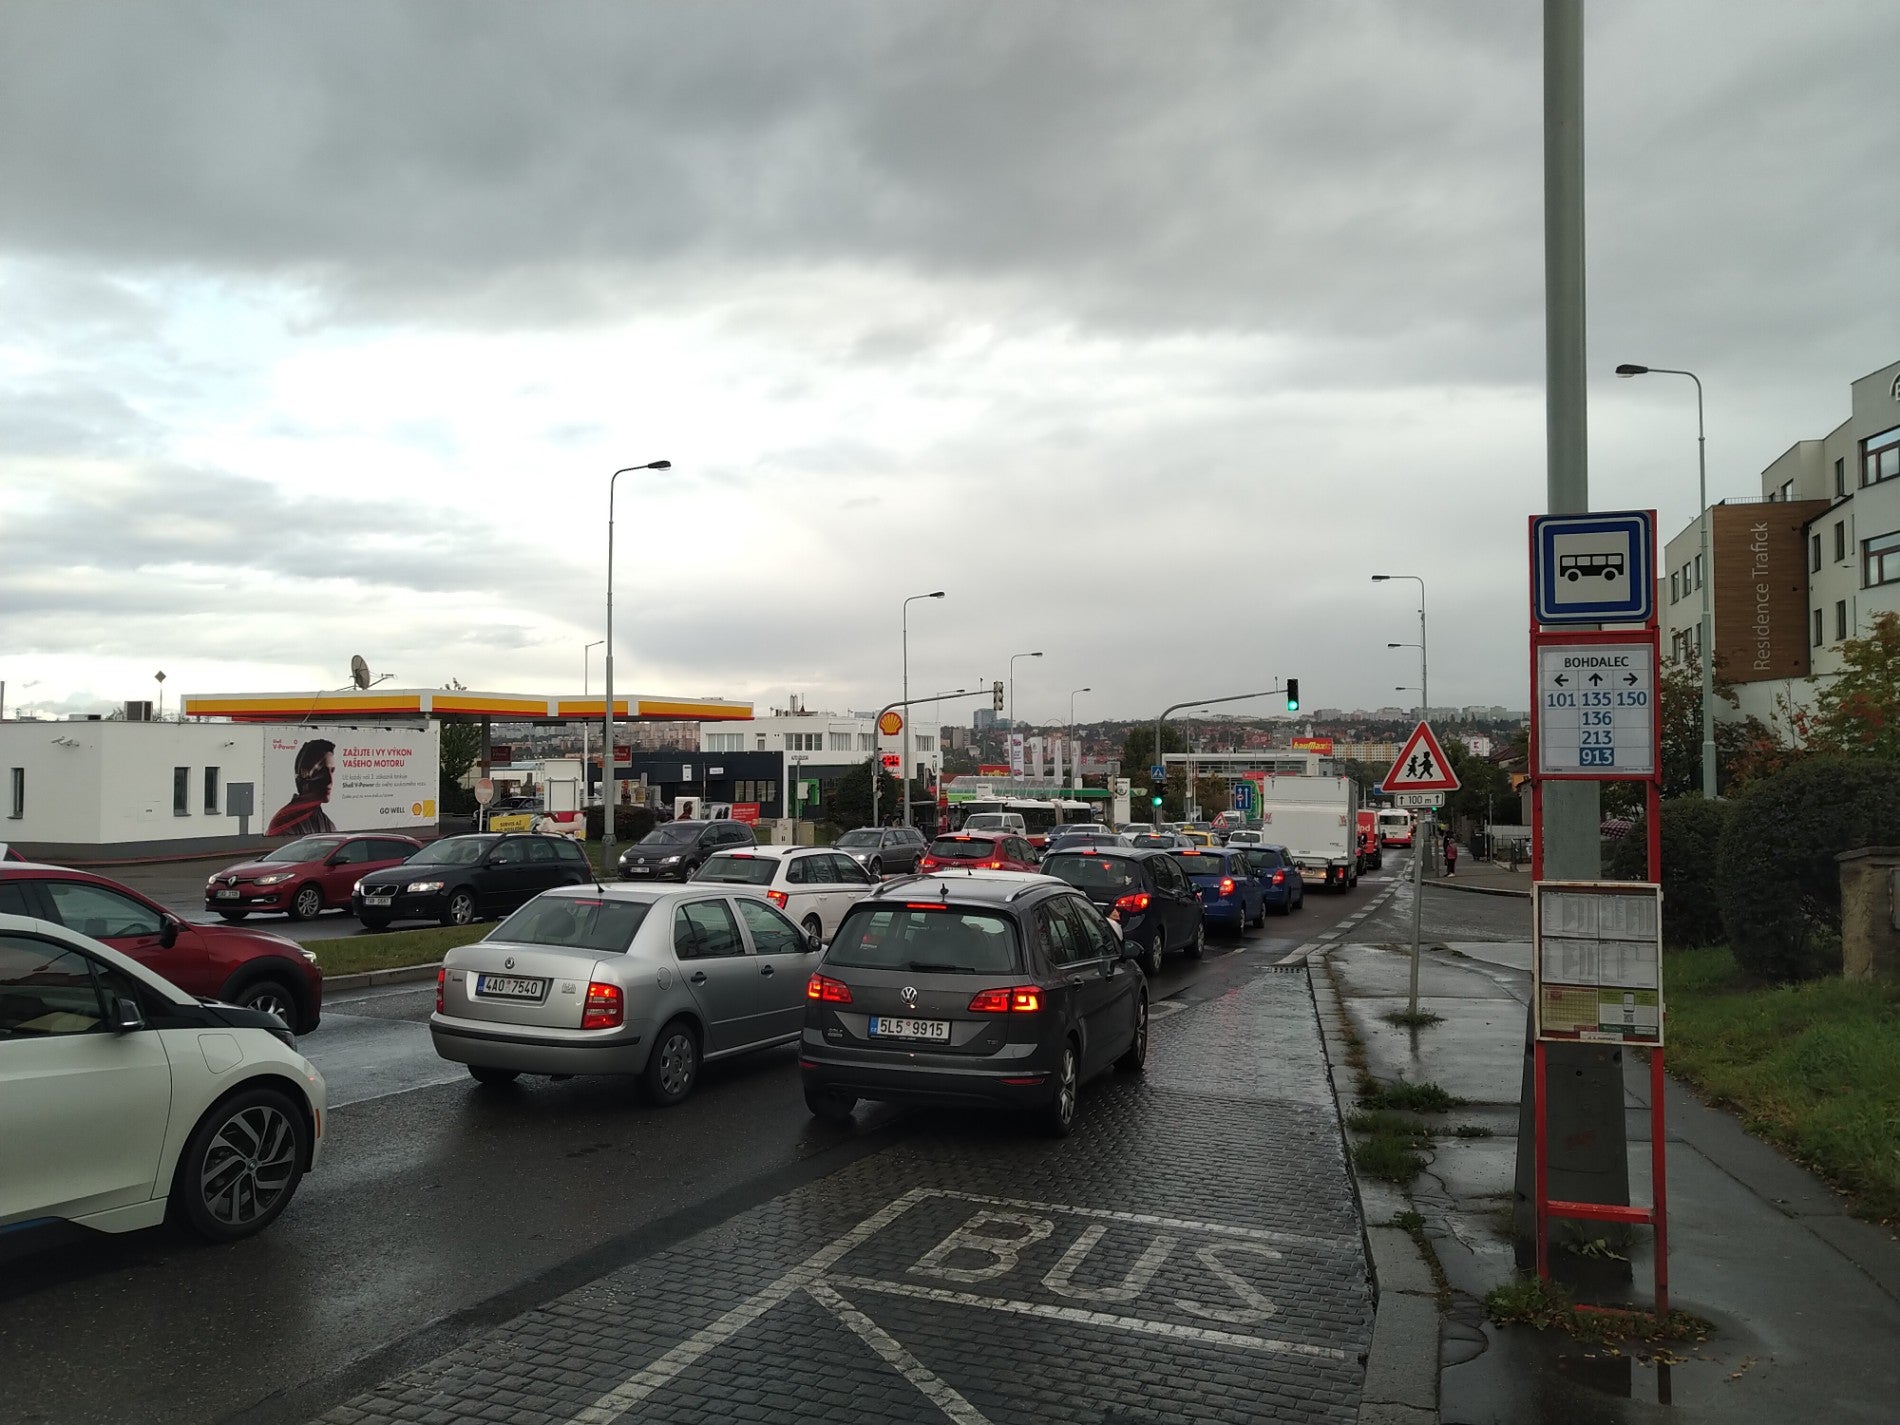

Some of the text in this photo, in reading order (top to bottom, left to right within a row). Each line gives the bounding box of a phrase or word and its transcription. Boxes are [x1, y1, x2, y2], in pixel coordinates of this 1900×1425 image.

[1751, 521, 1770, 671] Residence Trafick
[1564, 656, 1629, 668] BOHDALEC
[1547, 691, 1647, 708] 101 135 150
[1582, 711, 1612, 726] 136
[1582, 730, 1612, 745] 213
[343, 746, 370, 757] ZAŽIJTE
[376, 748, 385, 756] VY
[387, 746, 412, 756] VÝKON
[1582, 749, 1613, 765] 913
[342, 757, 405, 768] VAŠEHO MOTORU
[1408, 796, 1423, 805] 100
[379, 806, 405, 815] GO WELL
[511, 980, 538, 995] 7540
[880, 1019, 944, 1037] 5L5 9915
[905, 1208, 1282, 1324] BUS
